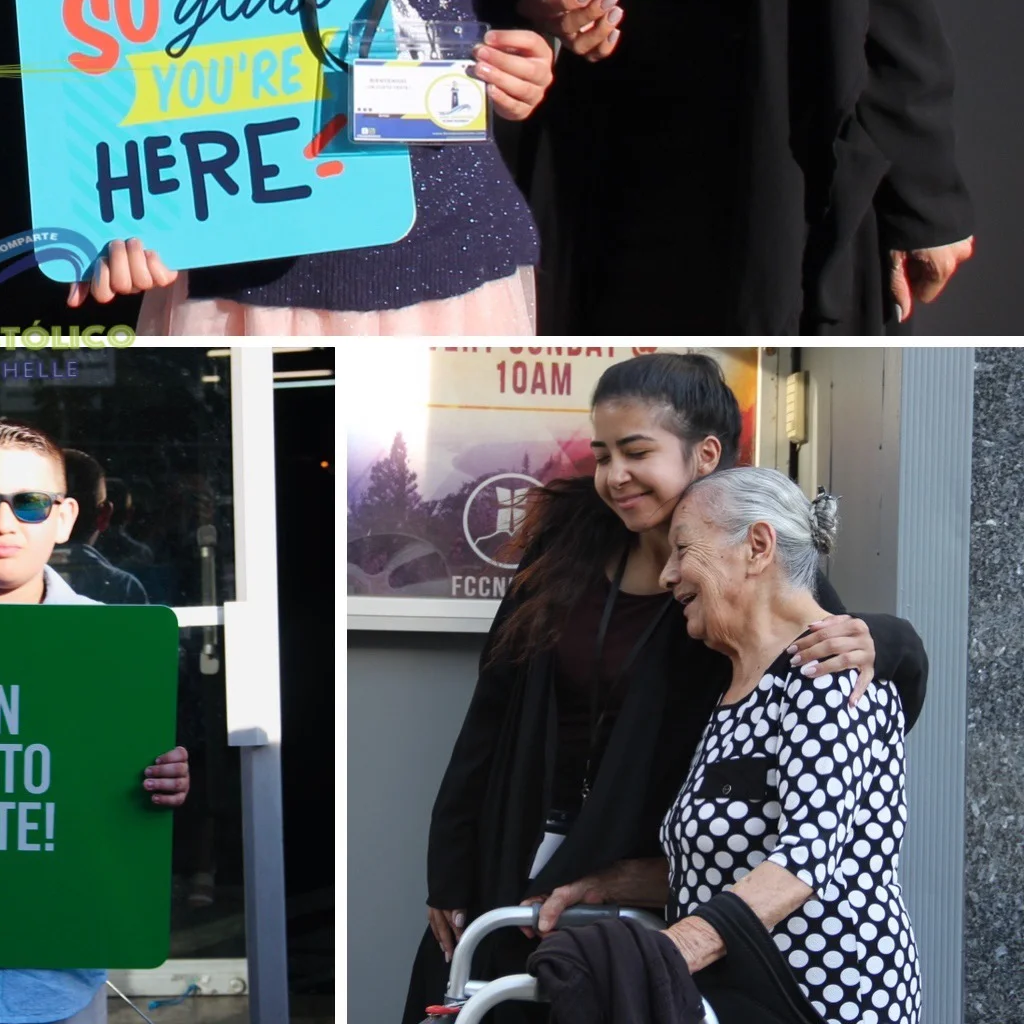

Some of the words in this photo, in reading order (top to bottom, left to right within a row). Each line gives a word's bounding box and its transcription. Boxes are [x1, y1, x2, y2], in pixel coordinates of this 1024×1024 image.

[151, 45, 304, 113] YOU'RE
[96, 113, 347, 223] HERE!
[496, 360, 572, 396] 10AM
[451, 575, 513, 597] FCCN
